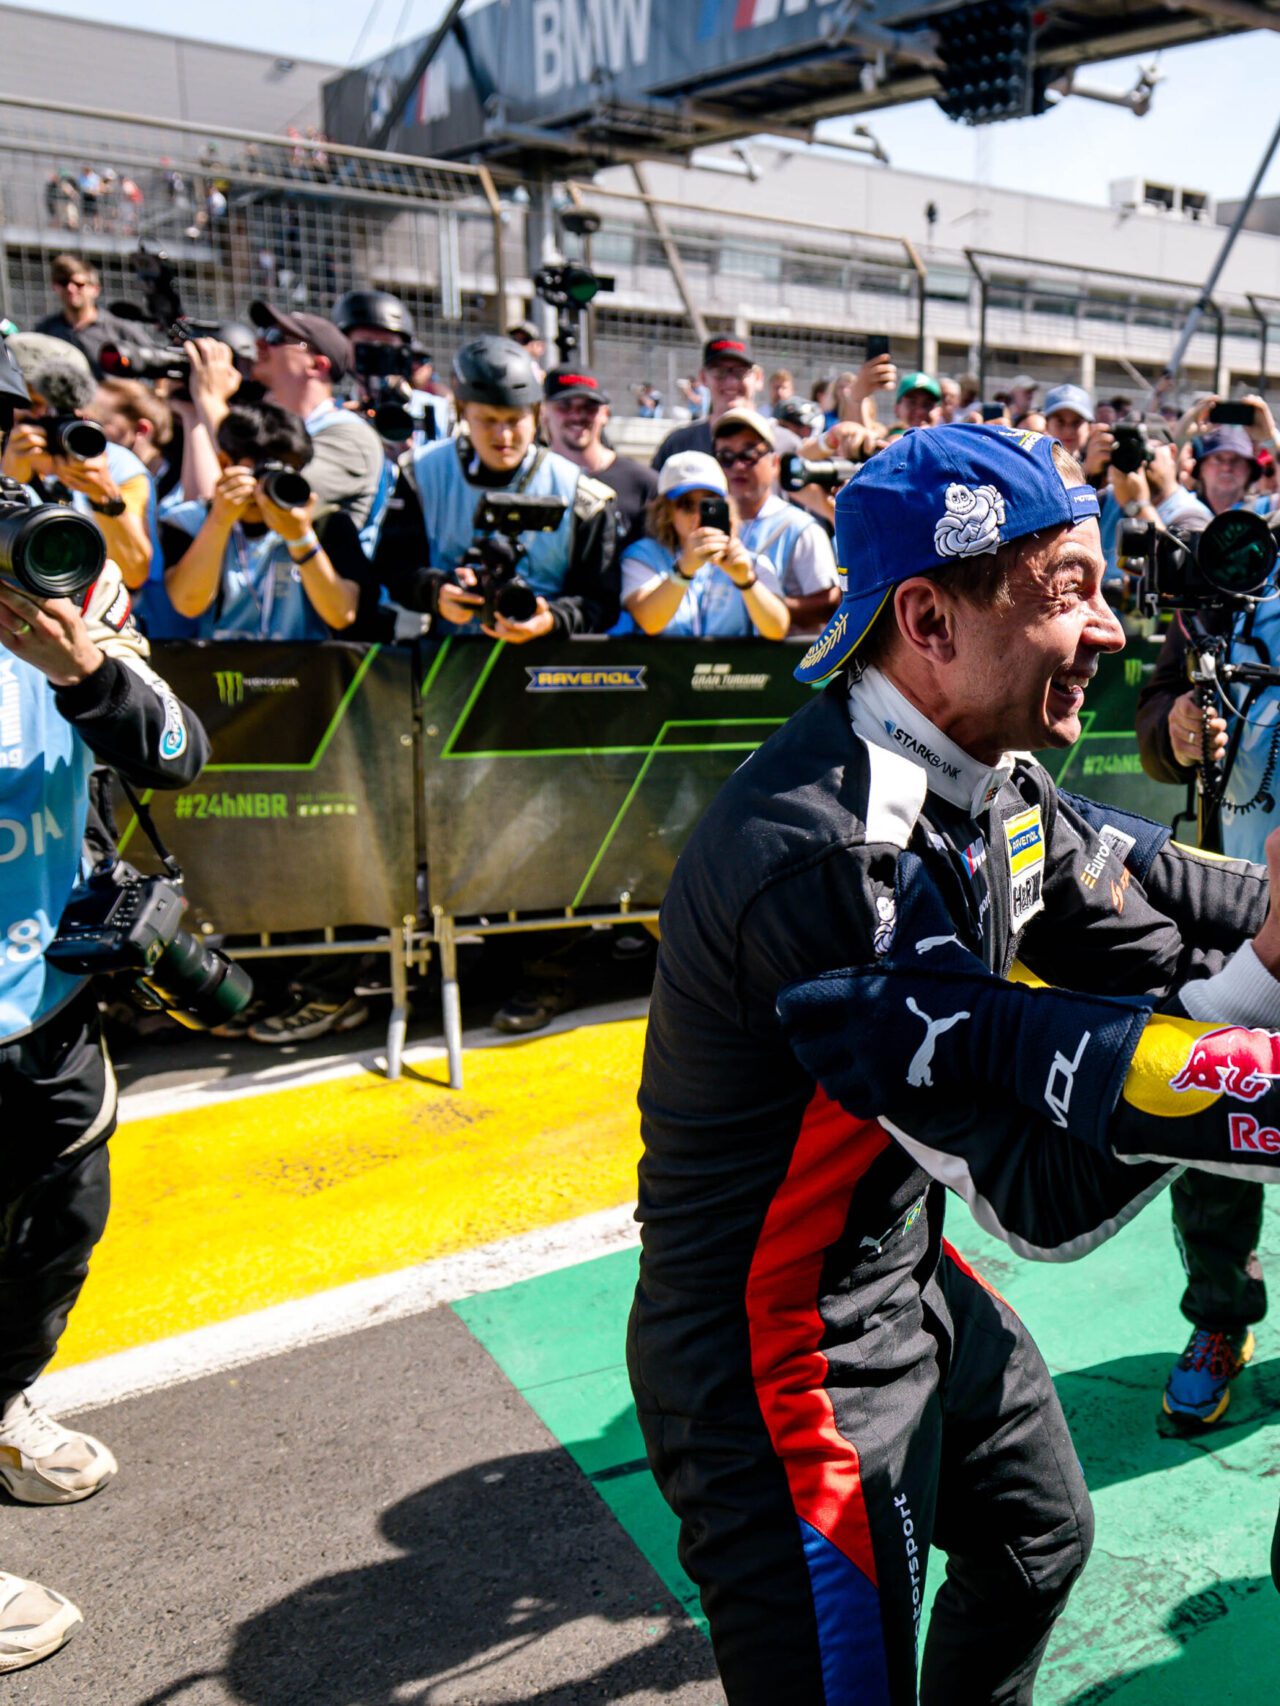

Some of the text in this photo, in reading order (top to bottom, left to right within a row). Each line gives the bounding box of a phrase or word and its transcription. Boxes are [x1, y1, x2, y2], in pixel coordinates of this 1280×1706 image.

[538, 672, 636, 685] RAVENOL
[894, 728, 961, 779] STARKBANK
[175, 793, 289, 819] #24hNBR
[893, 1492, 924, 1670] otorsport
